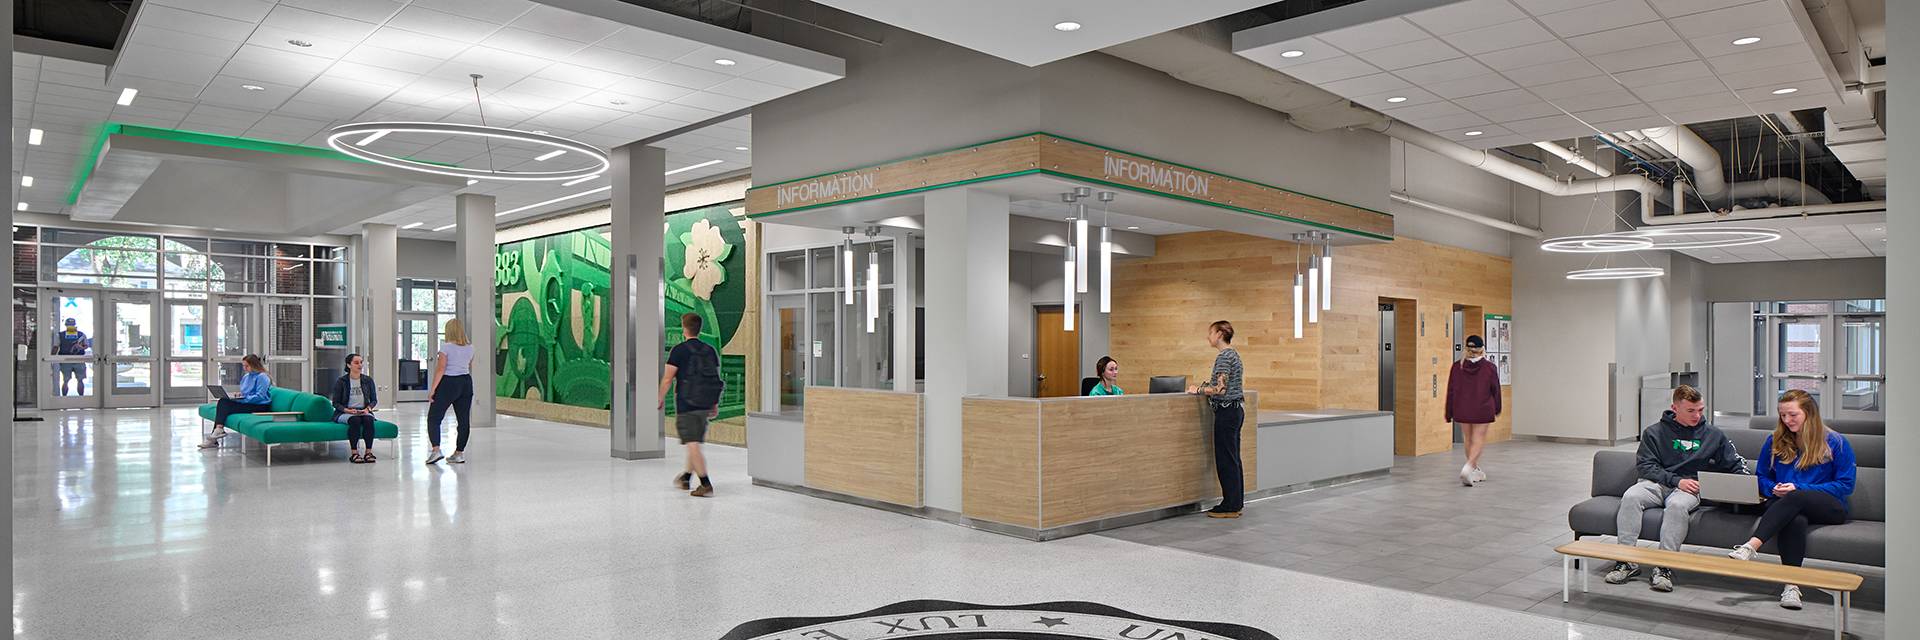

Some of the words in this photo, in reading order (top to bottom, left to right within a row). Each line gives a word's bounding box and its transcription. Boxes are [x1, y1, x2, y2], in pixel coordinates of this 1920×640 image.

[776, 173, 874, 207] INFORMATION
[1103, 155, 1209, 196] INFORMATION
[869, 613, 988, 634] LUX
